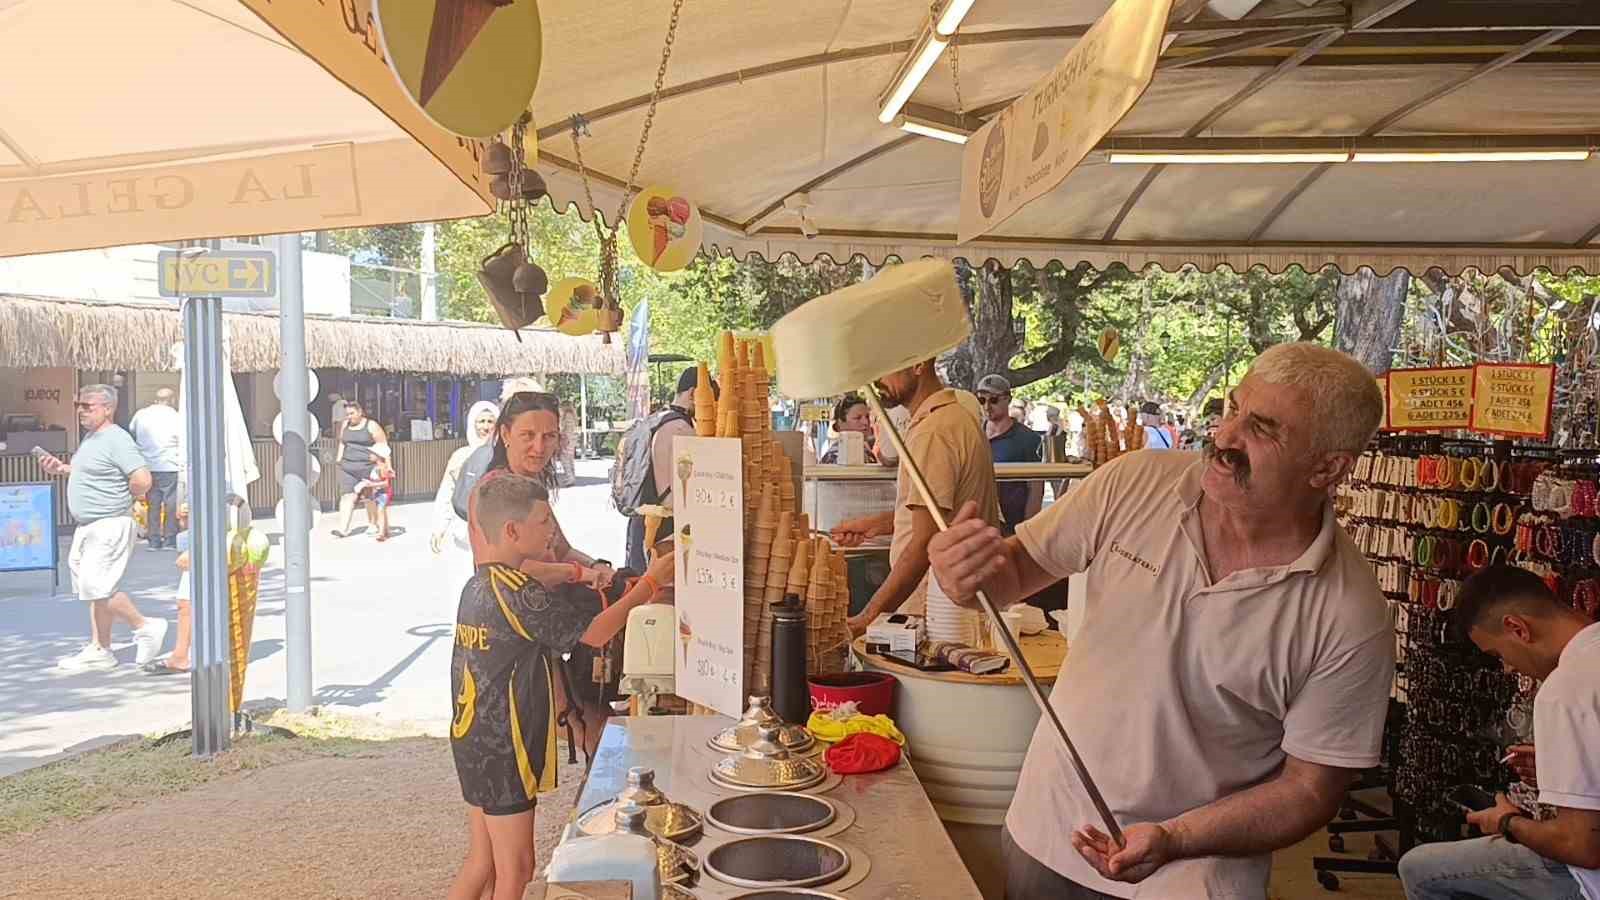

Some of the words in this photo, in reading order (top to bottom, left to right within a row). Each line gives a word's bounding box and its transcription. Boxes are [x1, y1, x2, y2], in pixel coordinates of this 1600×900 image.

[1031, 54, 1081, 119] TURKISH
[170, 263, 219, 285] WC
[1418, 375, 1448, 386] STÜCK
[1418, 387, 1449, 398] STÜCK
[1496, 383, 1522, 393] STÜCK
[1420, 399, 1444, 409] ADET
[1415, 410, 1441, 420] ADET
